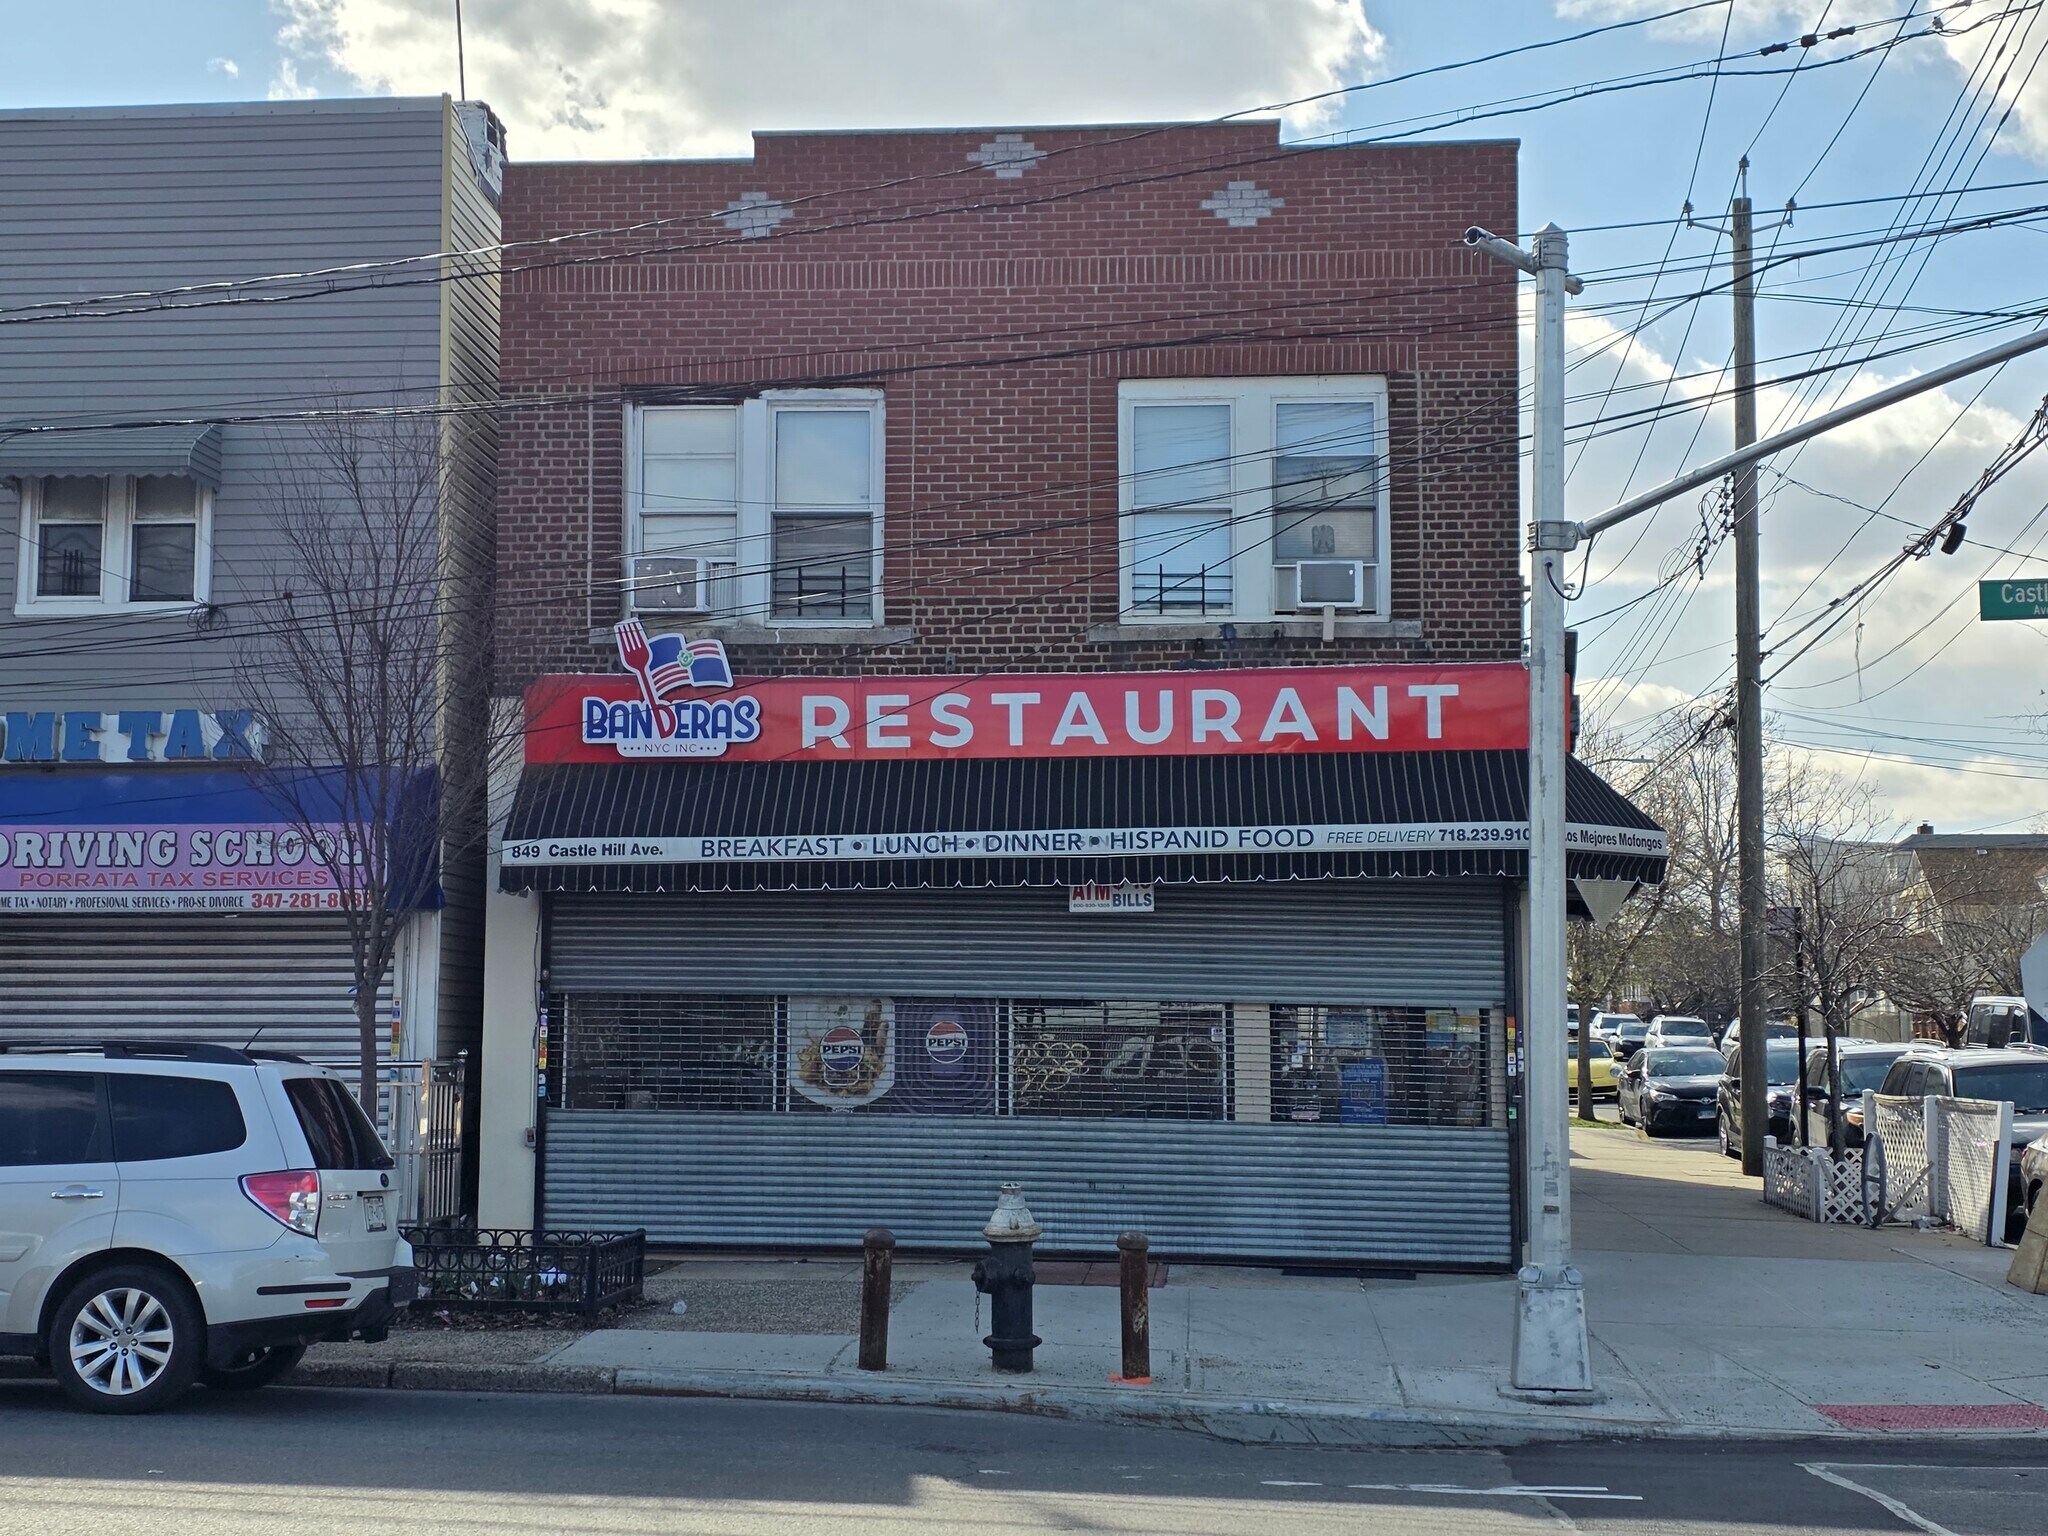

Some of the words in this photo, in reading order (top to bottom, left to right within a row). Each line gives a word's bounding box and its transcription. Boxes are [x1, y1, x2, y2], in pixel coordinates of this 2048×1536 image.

[2002, 583, 2048, 603] Castl
[2034, 604, 2048, 616] Av
[586, 699, 755, 739] BANDERAS
[802, 684, 1459, 749] RESTAURANT
[0, 711, 101, 761] ME
[118, 709, 256, 761] TAX
[644, 743, 670, 753] NYC
[675, 743, 697, 753] INC
[701, 837, 844, 858] BREAKFAST
[872, 834, 958, 855] LUNCH
[985, 832, 1082, 852] DINNER
[1110, 830, 1229, 850] HISPANID
[1238, 829, 1315, 848] FOOD
[1327, 831, 1363, 844] FREE
[1367, 830, 1436, 844] DELIVERY
[1565, 831, 1578, 843] os
[1580, 829, 1617, 847] Mejores
[1619, 832, 1663, 851] Mofongos
[189, 829, 369, 867] SCHOOL
[511, 845, 540, 858] 849
[548, 844, 597, 858] Castle
[601, 843, 626, 856] Hill
[630, 843, 664, 856] Ave.
[20, 872, 139, 888] PORRATA
[147, 872, 194, 887] TAX
[202, 870, 328, 887] SERVICES
[14, 896, 30, 908] TAX
[36, 896, 67, 908] NOTARY
[75, 896, 130, 908] PROFESIONAL
[131, 896, 170, 908] SERVICES
[177, 896, 208, 908] PRO-SE
[209, 895, 244, 908] DIVORCE
[1112, 892, 1152, 907] BILLS
[822, 1044, 861, 1054] PEPSI
[928, 1037, 966, 1047] PEPSI
